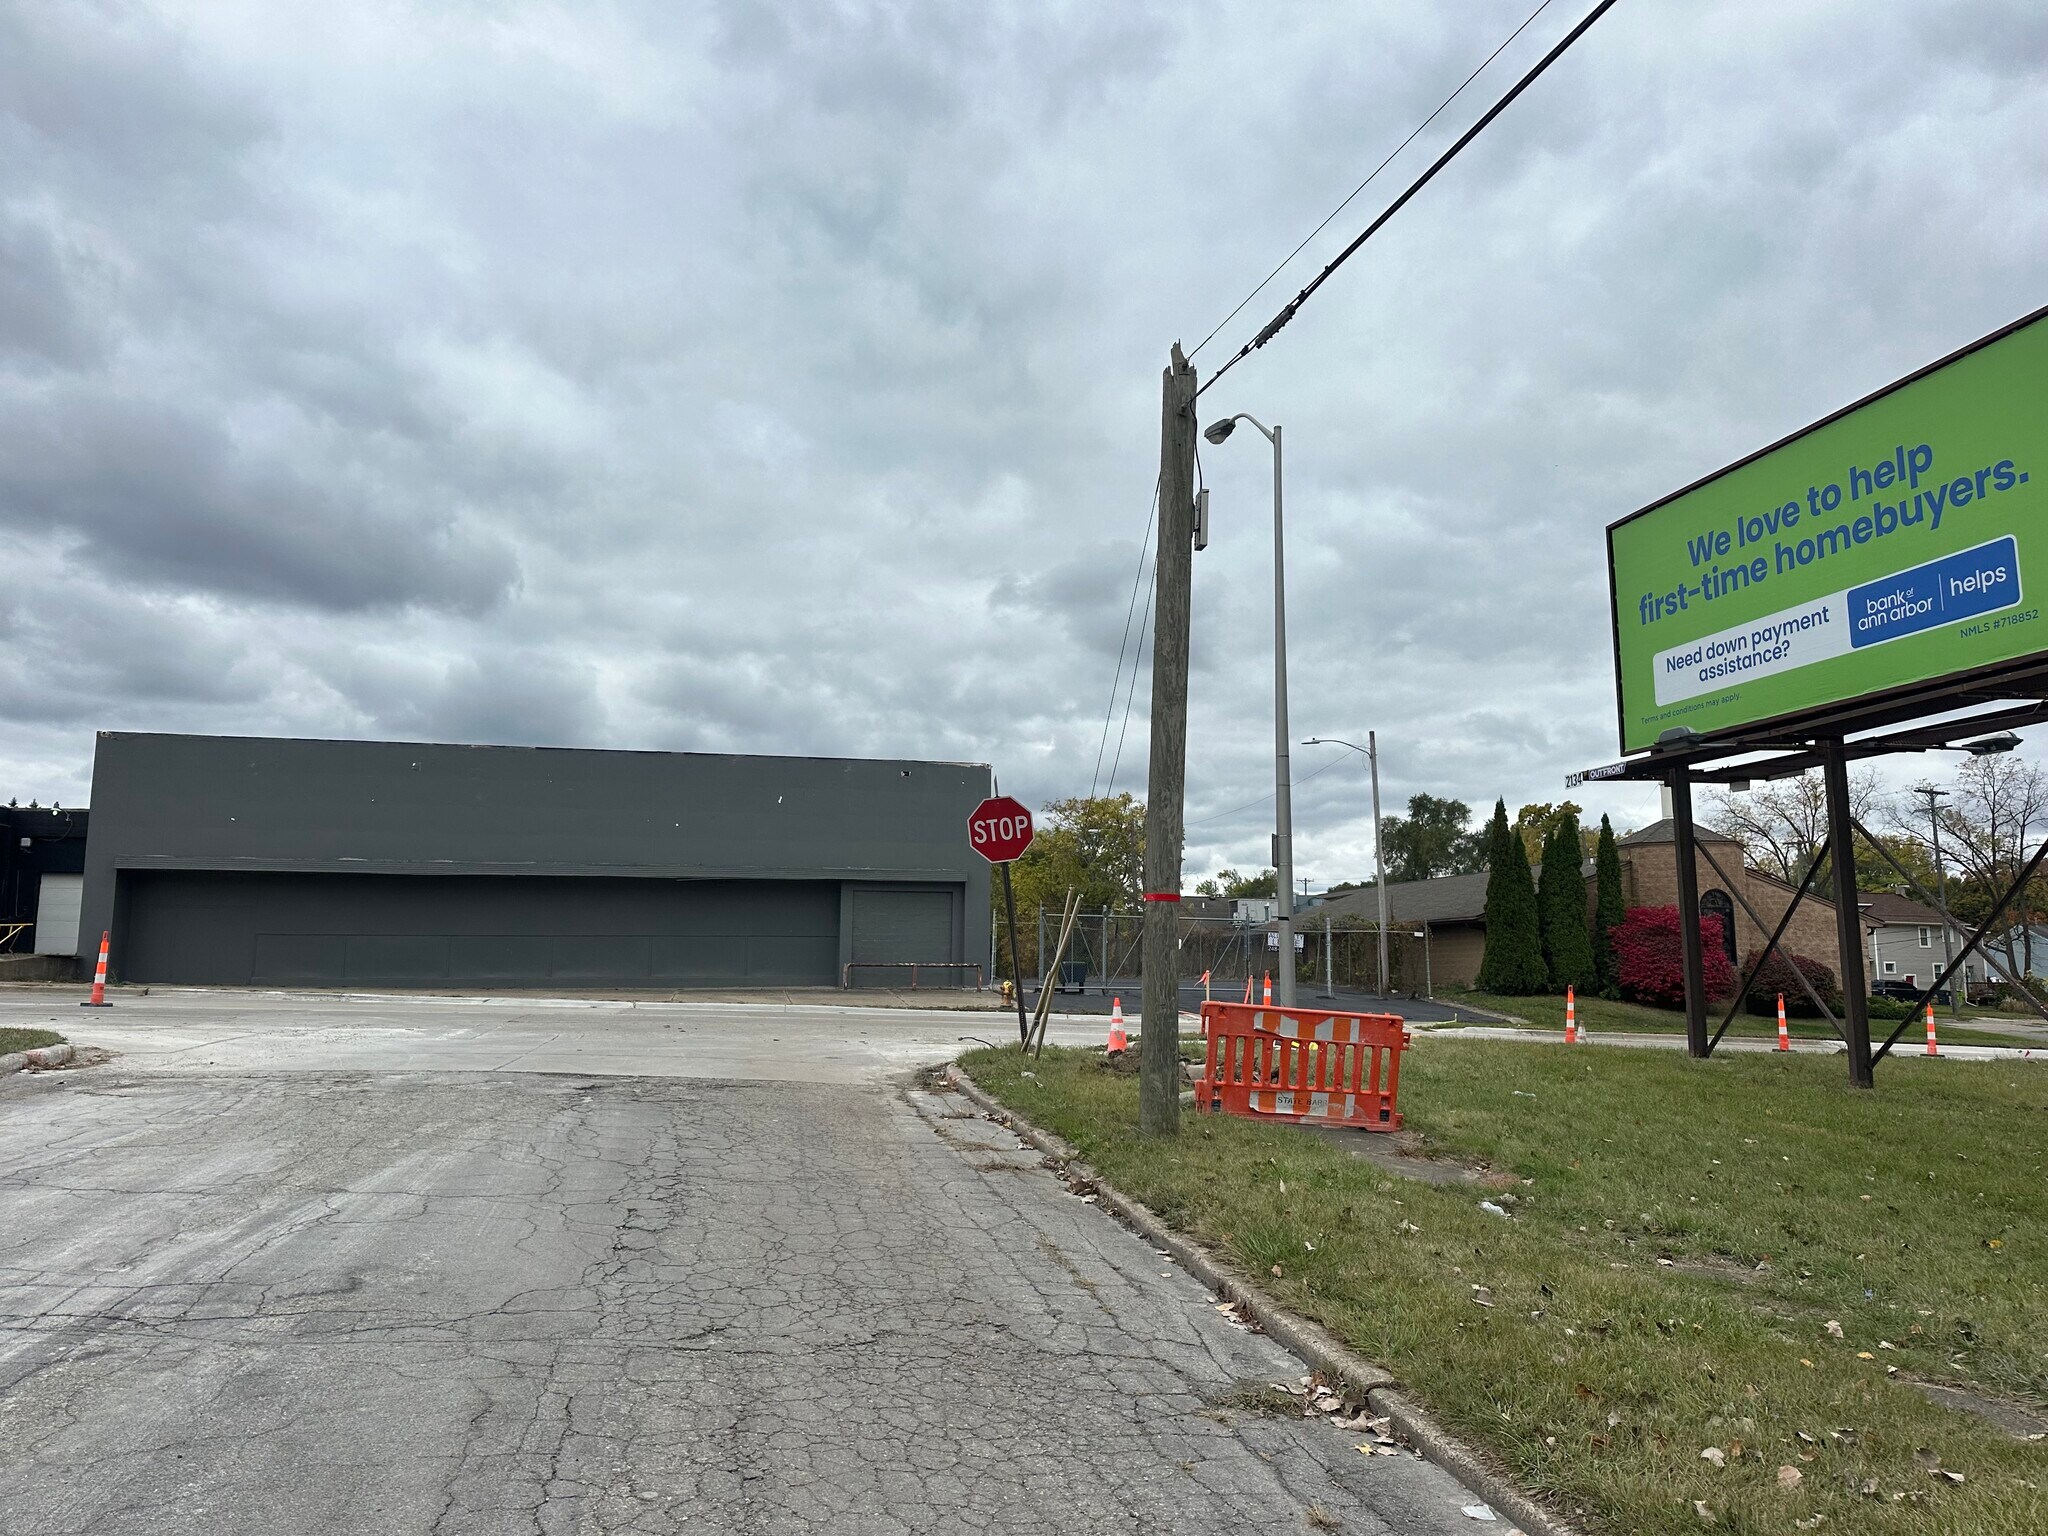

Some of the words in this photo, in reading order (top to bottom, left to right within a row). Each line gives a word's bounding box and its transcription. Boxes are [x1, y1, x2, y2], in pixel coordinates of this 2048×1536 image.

[1687, 530, 1731, 567] We
[1738, 501, 1800, 548] love
[1807, 484, 1842, 517] to
[1849, 444, 1933, 501] help
[1639, 557, 1768, 626] first-time
[1774, 459, 2029, 575] homebuyers.
[1950, 566, 2007, 597] helps
[1858, 612, 1888, 631] ann
[1889, 597, 1933, 622] arbor
[1866, 590, 1906, 614] bank
[1906, 587, 1914, 598] of
[1960, 622, 1991, 638] NMLS
[1993, 609, 2039, 630] #718852
[1666, 646, 1703, 673] Need
[1706, 642, 1747, 660] down
[1751, 606, 1830, 651] payment
[1698, 639, 1790, 682] assistance?
[1641, 715, 1659, 725] Terms
[1660, 710, 1671, 720] and
[1672, 702, 1705, 717] conditions
[1706, 698, 1720, 707] may
[1721, 692, 1742, 703] apply.
[1565, 773, 1583, 788] 2134
[1589, 763, 1625, 779] OUTFRONT
[974, 815, 1028, 844] STOP
[1277, 1096, 1303, 1105] STATE
